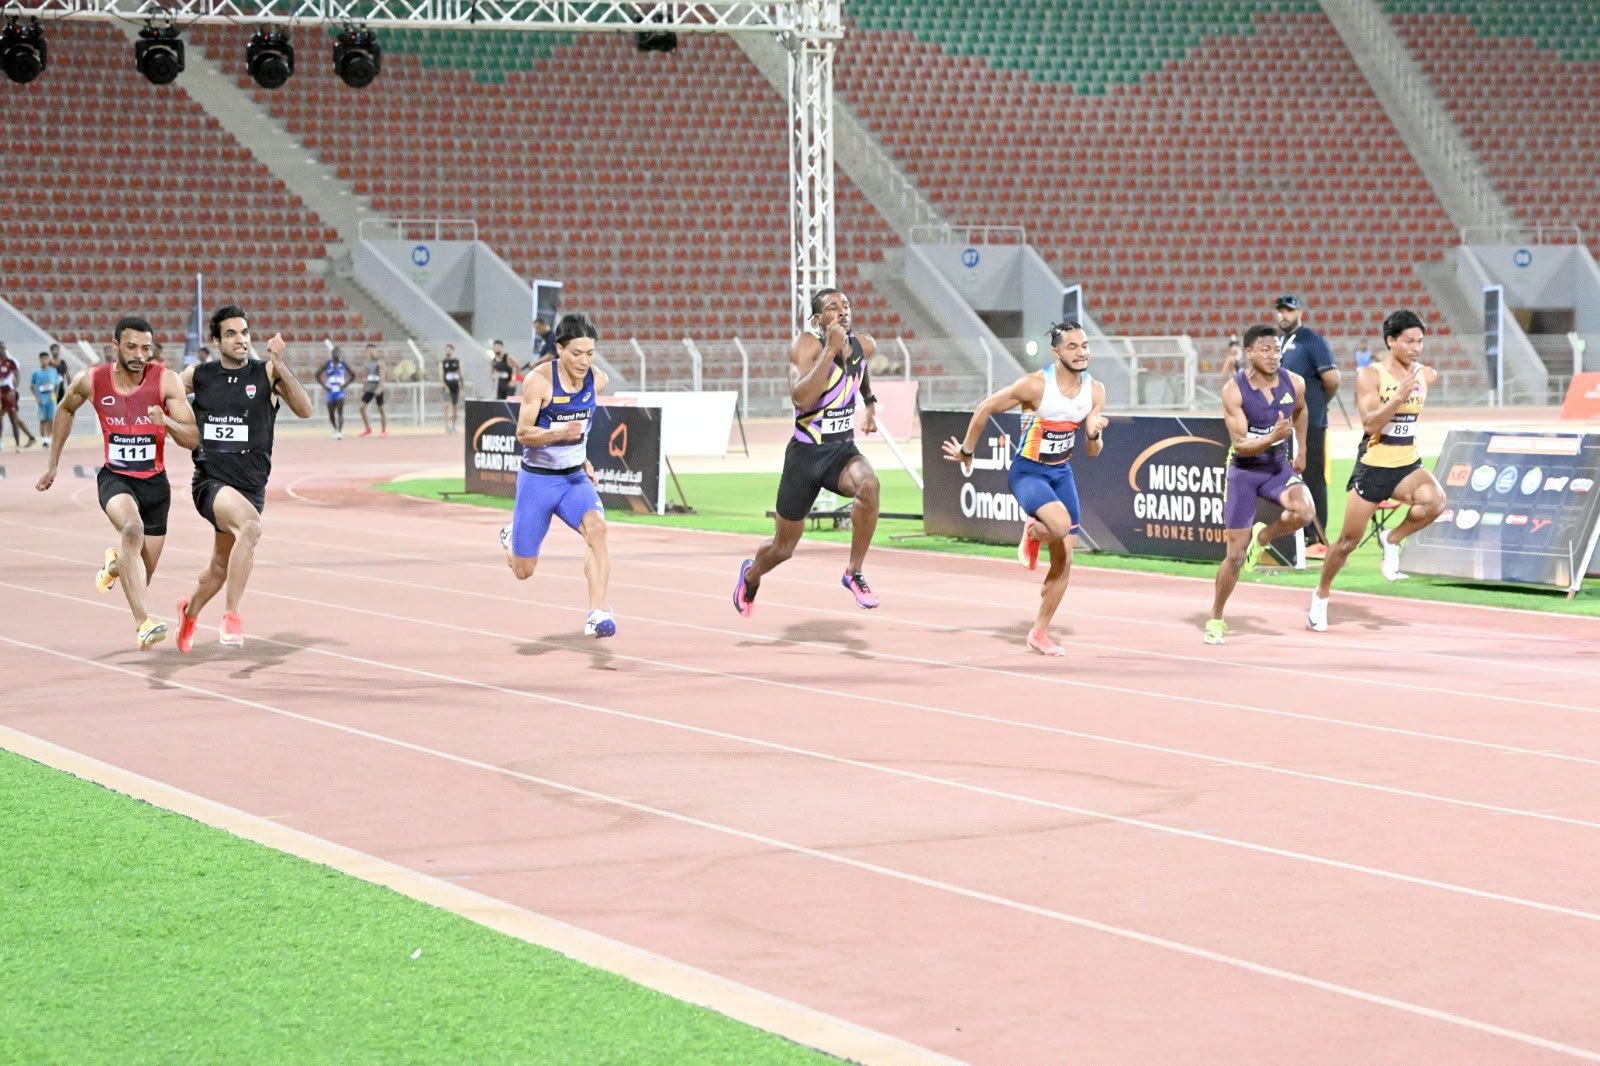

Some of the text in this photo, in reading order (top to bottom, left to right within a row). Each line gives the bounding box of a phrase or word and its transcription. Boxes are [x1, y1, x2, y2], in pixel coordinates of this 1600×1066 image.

[208, 415, 227, 423] Grand
[557, 413, 575, 421] Grand
[829, 418, 850, 431] 175
[1394, 425, 1409, 434] 89
[215, 427, 234, 439] 52
[113, 435, 151, 444] Grand Prix
[482, 434, 516, 452] MUSCAT
[118, 447, 147, 459] 111
[474, 452, 503, 470] GRAND
[1149, 464, 1224, 494] MUSCAT
[1133, 493, 1224, 525] GRAND PR
[1146, 523, 1194, 541] BRONZE
